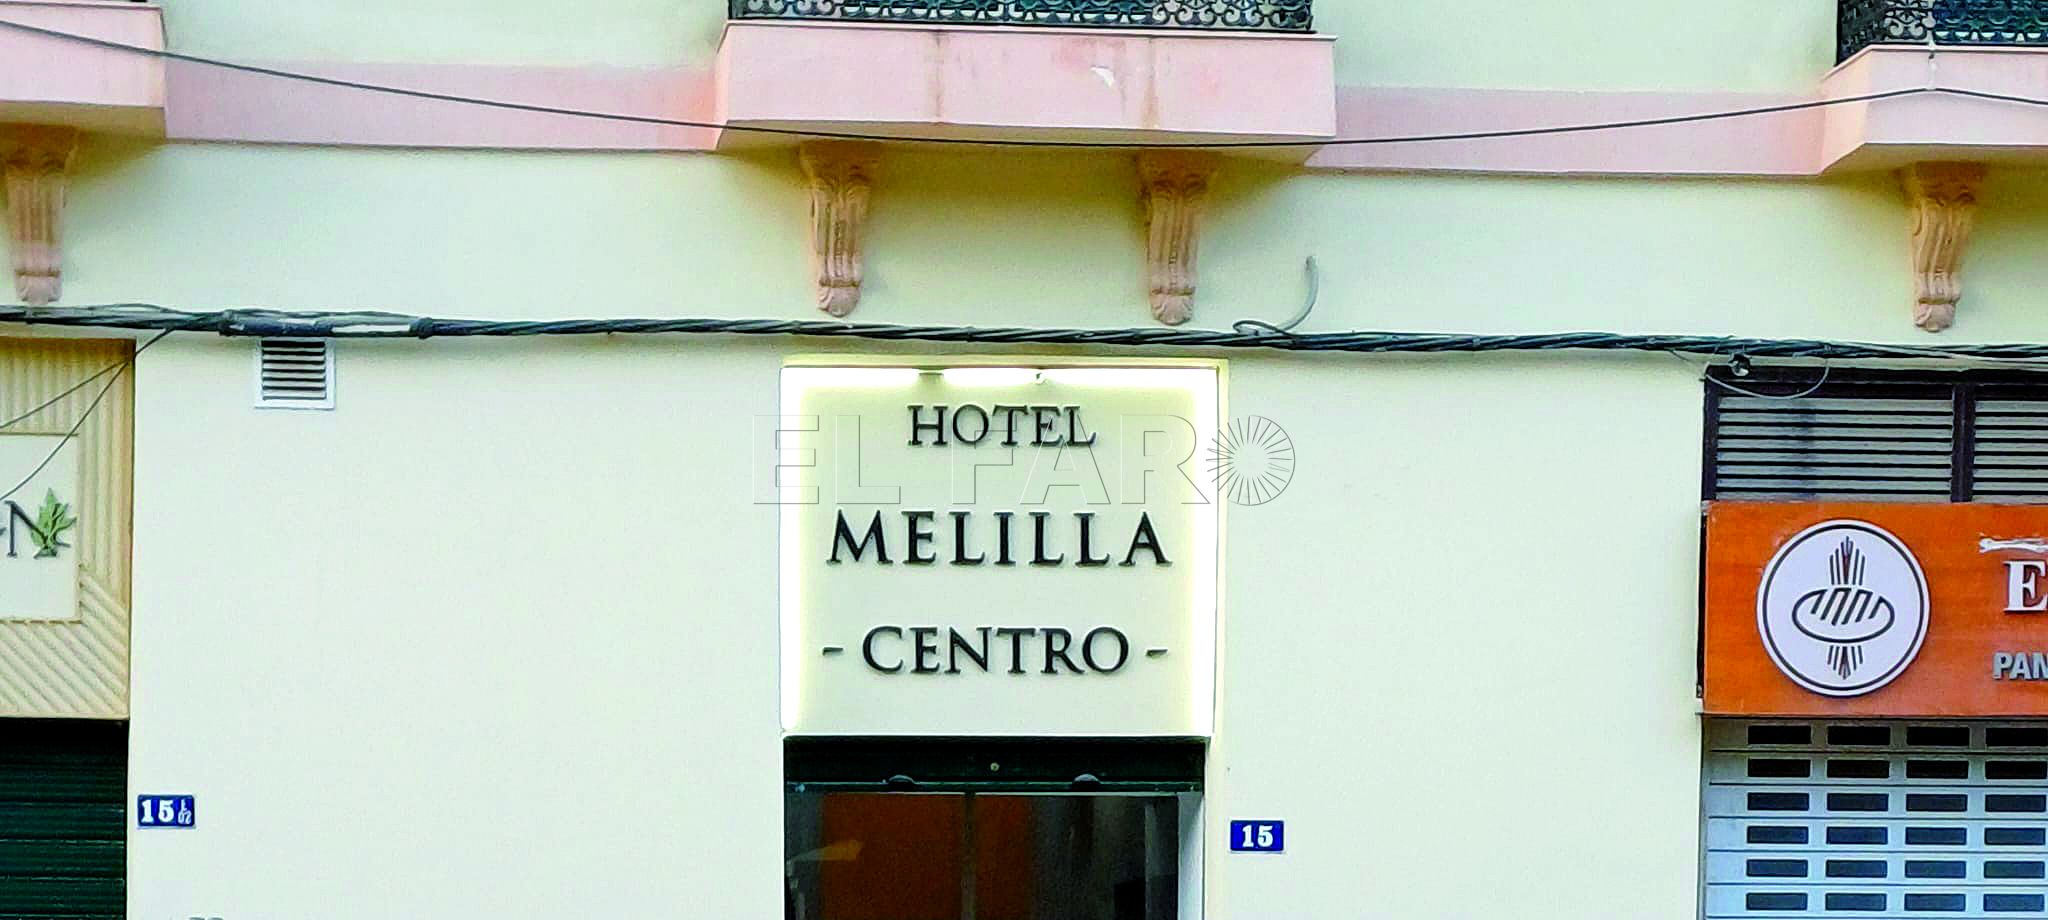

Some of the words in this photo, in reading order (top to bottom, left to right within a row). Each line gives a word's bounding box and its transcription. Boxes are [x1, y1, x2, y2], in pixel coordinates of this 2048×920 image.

[906, 403, 1097, 448] HOTEL
[825, 508, 1173, 567] MELILLA
[861, 625, 1131, 675] CENTRO
[141, 798, 175, 823] 15
[1242, 824, 1274, 848] 15
